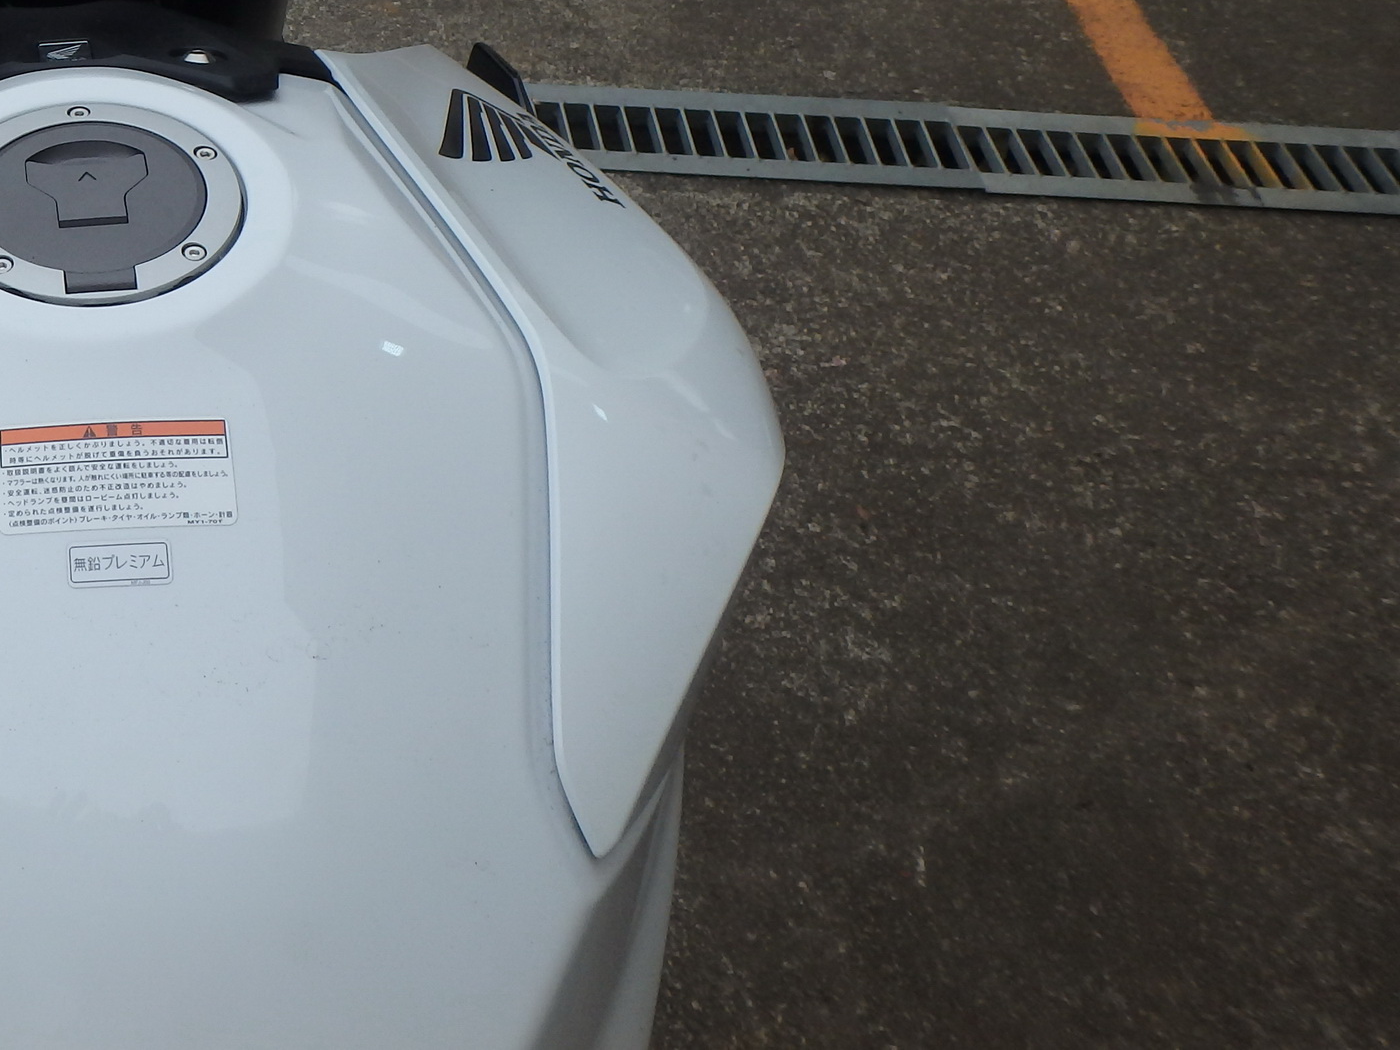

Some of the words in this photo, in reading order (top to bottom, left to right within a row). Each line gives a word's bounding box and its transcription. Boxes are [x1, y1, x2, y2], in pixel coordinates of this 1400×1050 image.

[73, 554, 165, 573] 無鉛プレミアム
